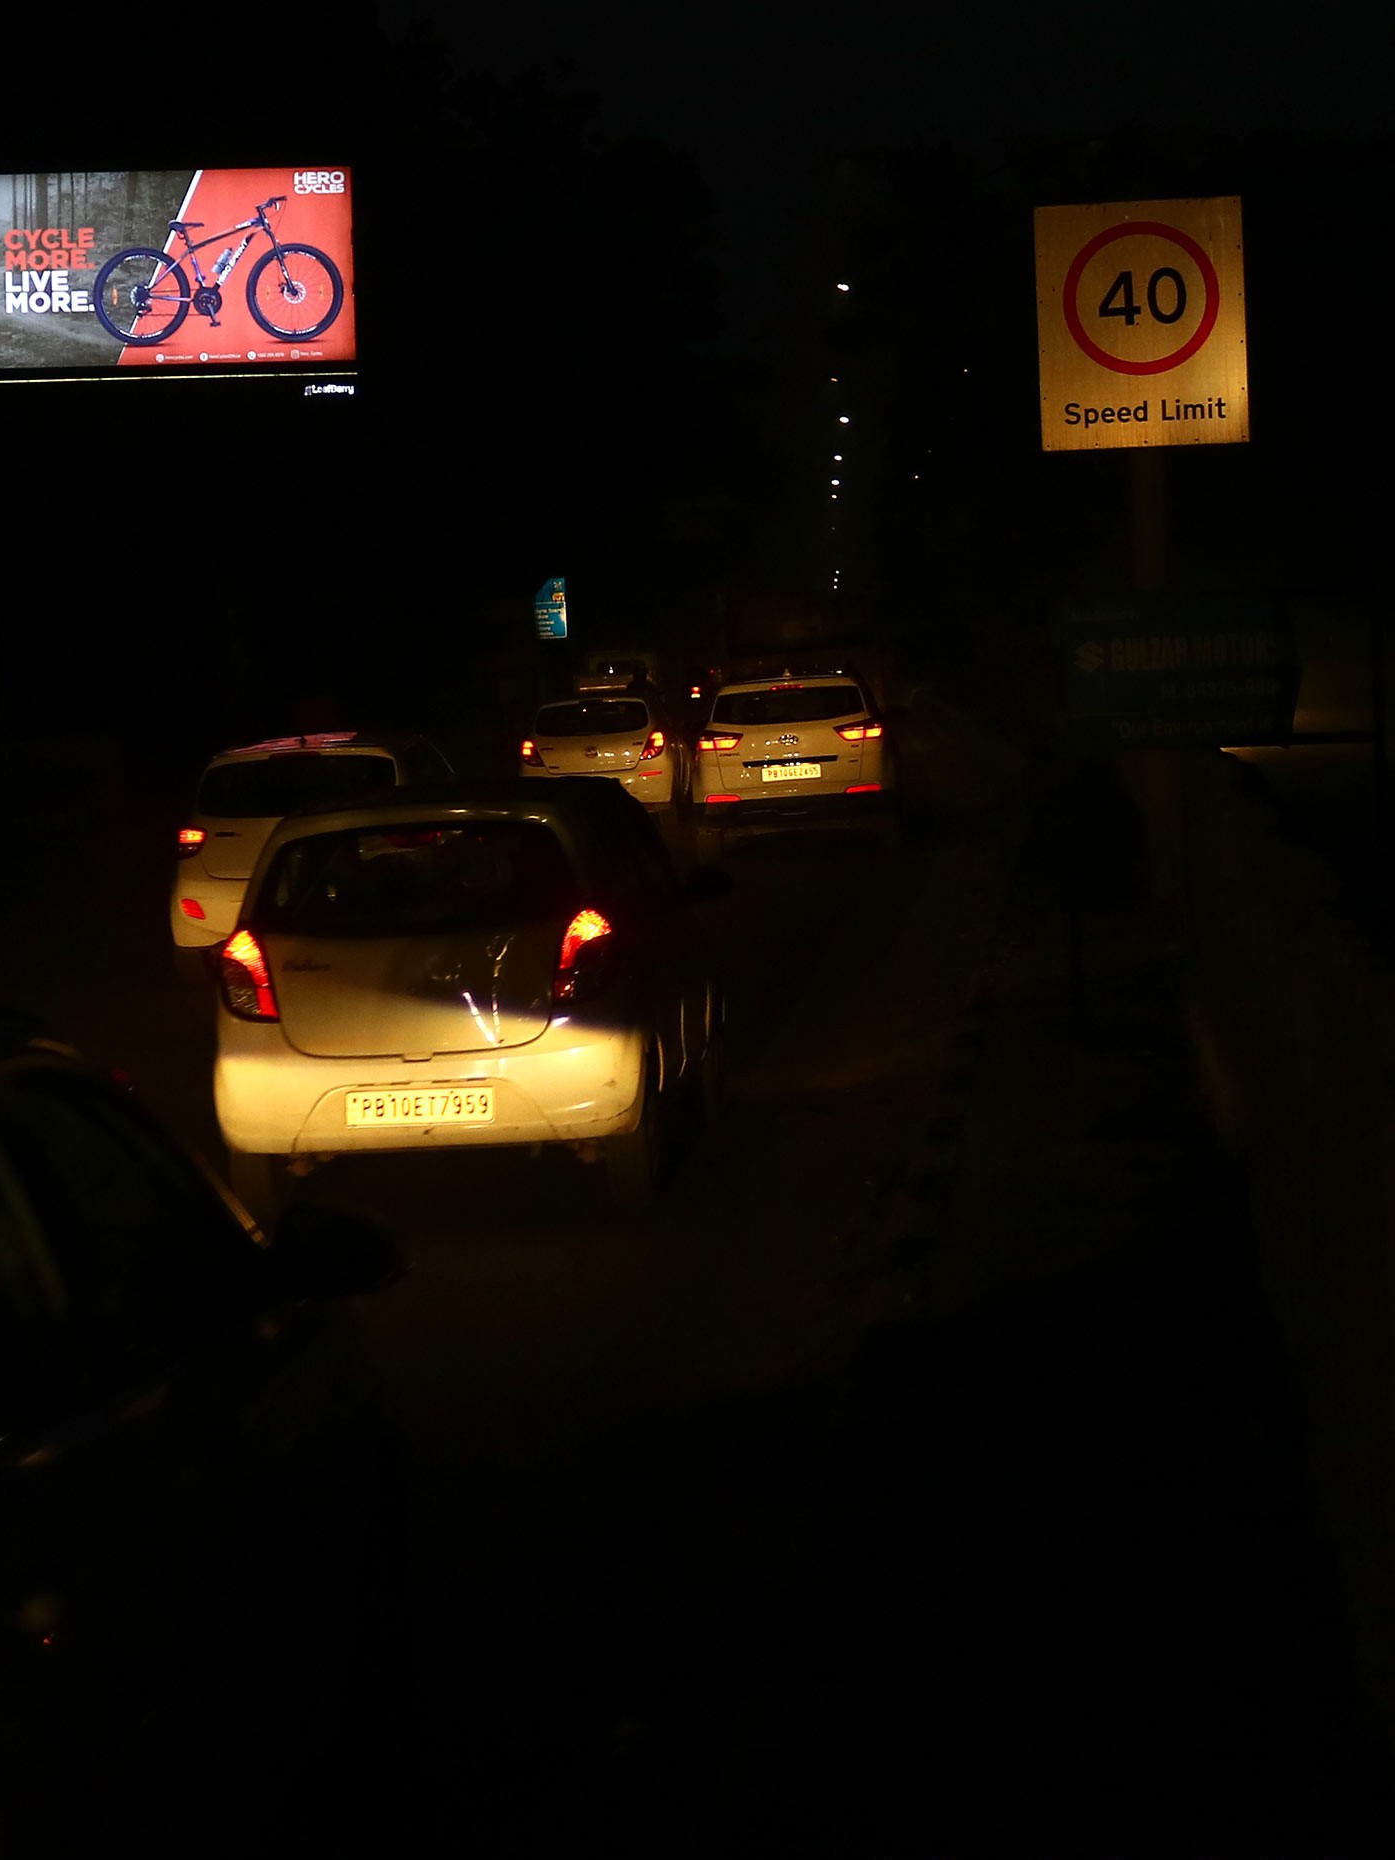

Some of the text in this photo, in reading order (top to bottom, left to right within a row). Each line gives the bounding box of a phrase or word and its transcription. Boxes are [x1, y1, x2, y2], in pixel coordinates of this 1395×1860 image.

[293, 171, 345, 185] HERO
[293, 183, 345, 195] CYCLES
[4, 227, 95, 250] CYCLE
[5, 249, 97, 270] MORE.
[5, 270, 69, 292] LIVE
[5, 290, 96, 314] MORE.
[1098, 266, 1188, 326] 40
[1064, 397, 1227, 429] Speed Limit
[362, 1094, 489, 1119] PB10ET7959
